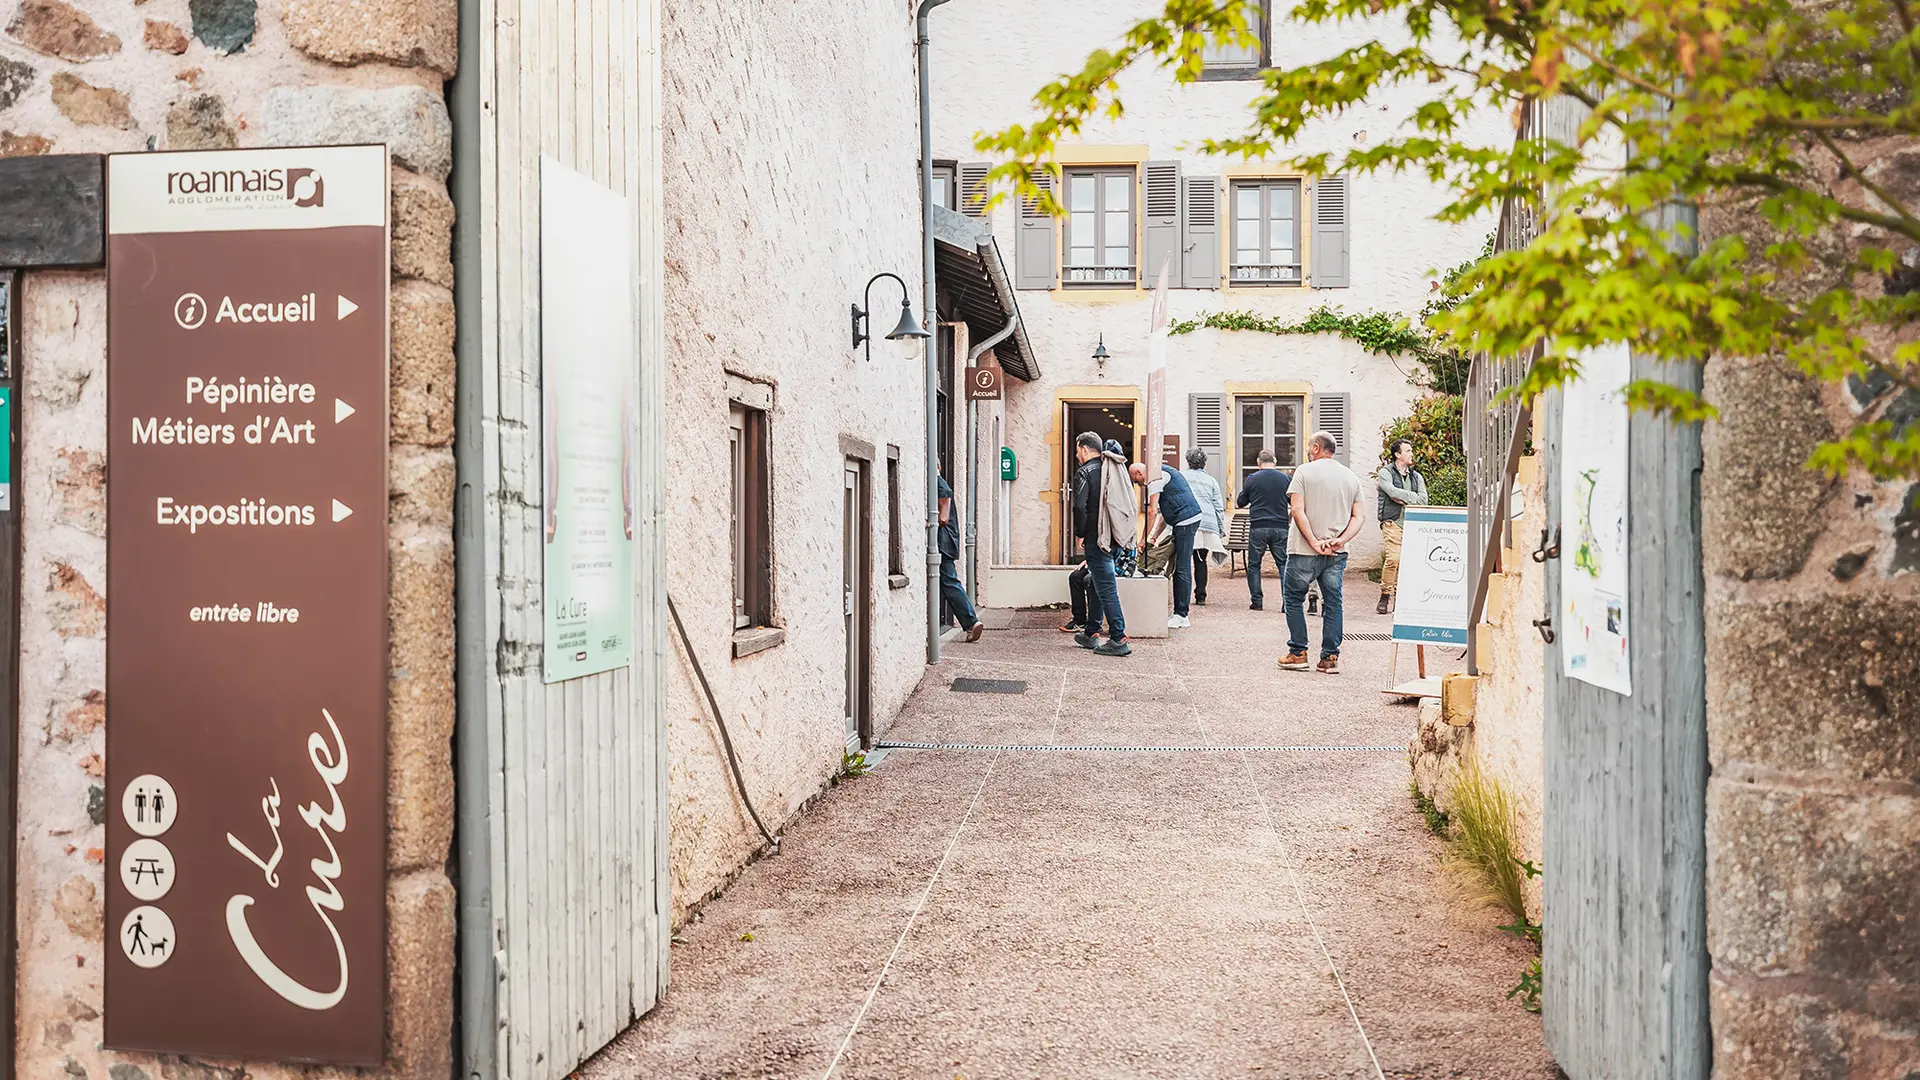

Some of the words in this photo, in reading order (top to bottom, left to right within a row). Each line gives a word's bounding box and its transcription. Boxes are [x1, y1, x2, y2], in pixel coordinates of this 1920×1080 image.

[168, 169, 284, 195] roannais
[215, 293, 316, 323] Accueil
[186, 375, 316, 413] Pépinière
[132, 416, 236, 445] Métiers
[157, 497, 316, 533] Expositions
[1429, 545, 1461, 562] Cure
[189, 602, 252, 623] entrée
[256, 601, 300, 623] libre
[226, 776, 283, 889] La
[225, 707, 349, 1011] Cure
